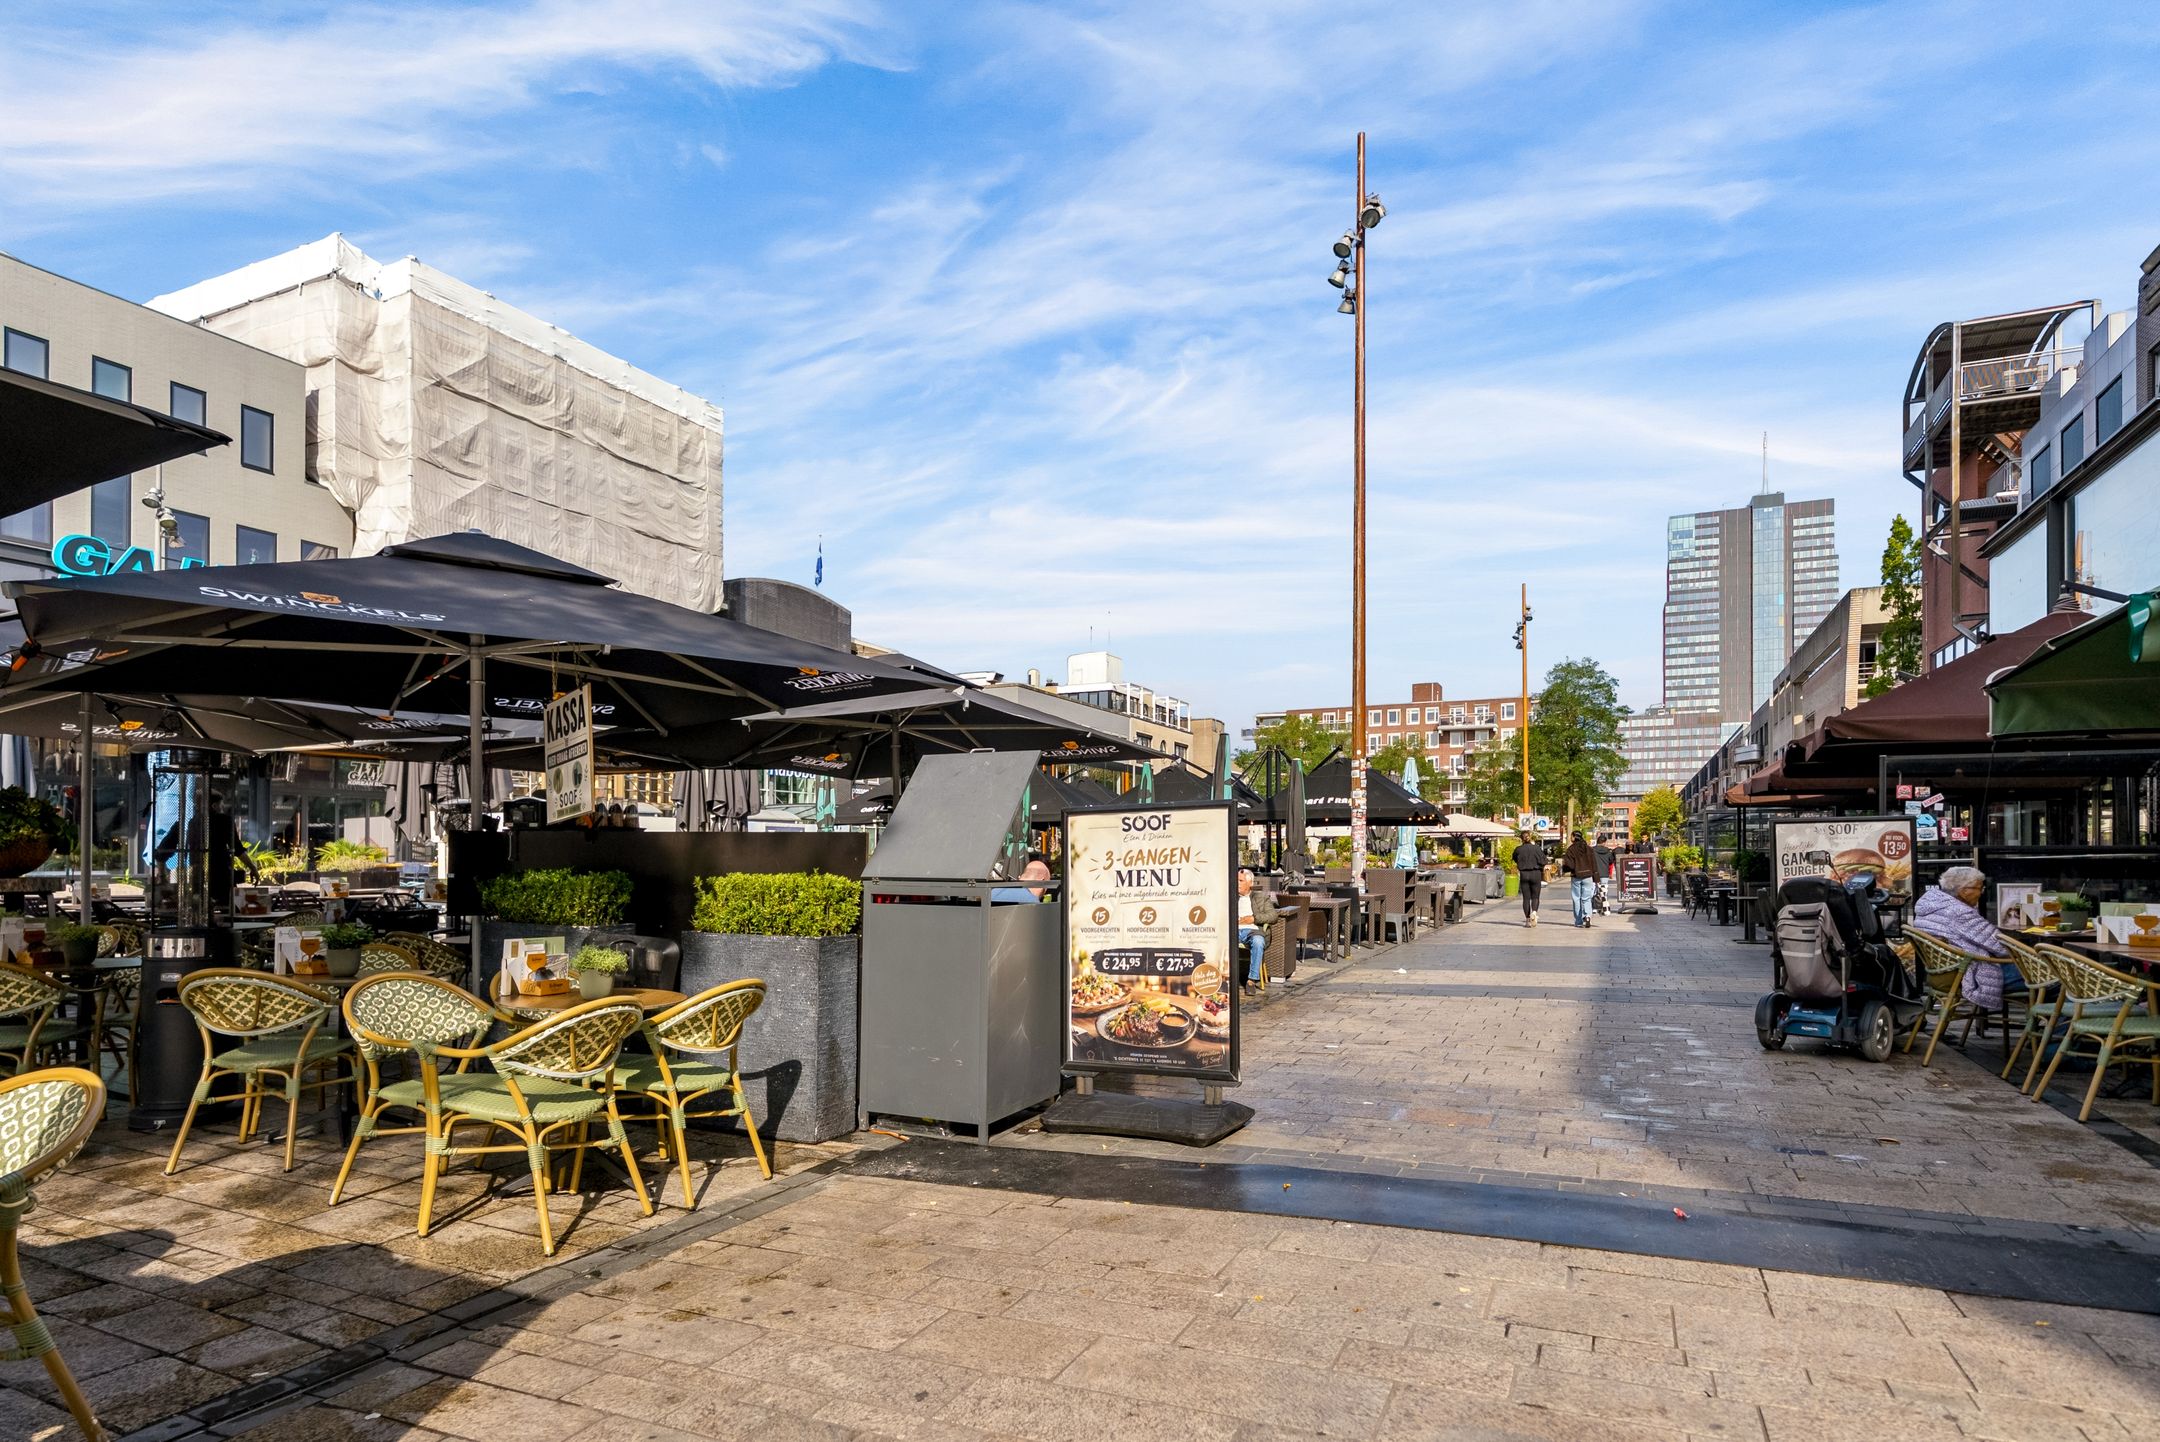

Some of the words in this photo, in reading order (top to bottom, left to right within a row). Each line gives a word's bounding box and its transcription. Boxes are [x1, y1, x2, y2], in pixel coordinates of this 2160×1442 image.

[547, 694, 586, 743] KASSA
[560, 789, 578, 808] SOOF
[1121, 814, 1172, 832] SOOF
[1828, 824, 1859, 835] SOOF
[1103, 846, 1192, 871] 3-GANGEN
[1784, 864, 1825, 877] BURGER
[1115, 868, 1182, 888] MENU
[1094, 911, 1106, 923] 15
[1141, 910, 1154, 922] 25
[1193, 910, 1201, 922] 7
[1112, 957, 1141, 971] 24,95
[1166, 958, 1194, 972] 27,95
